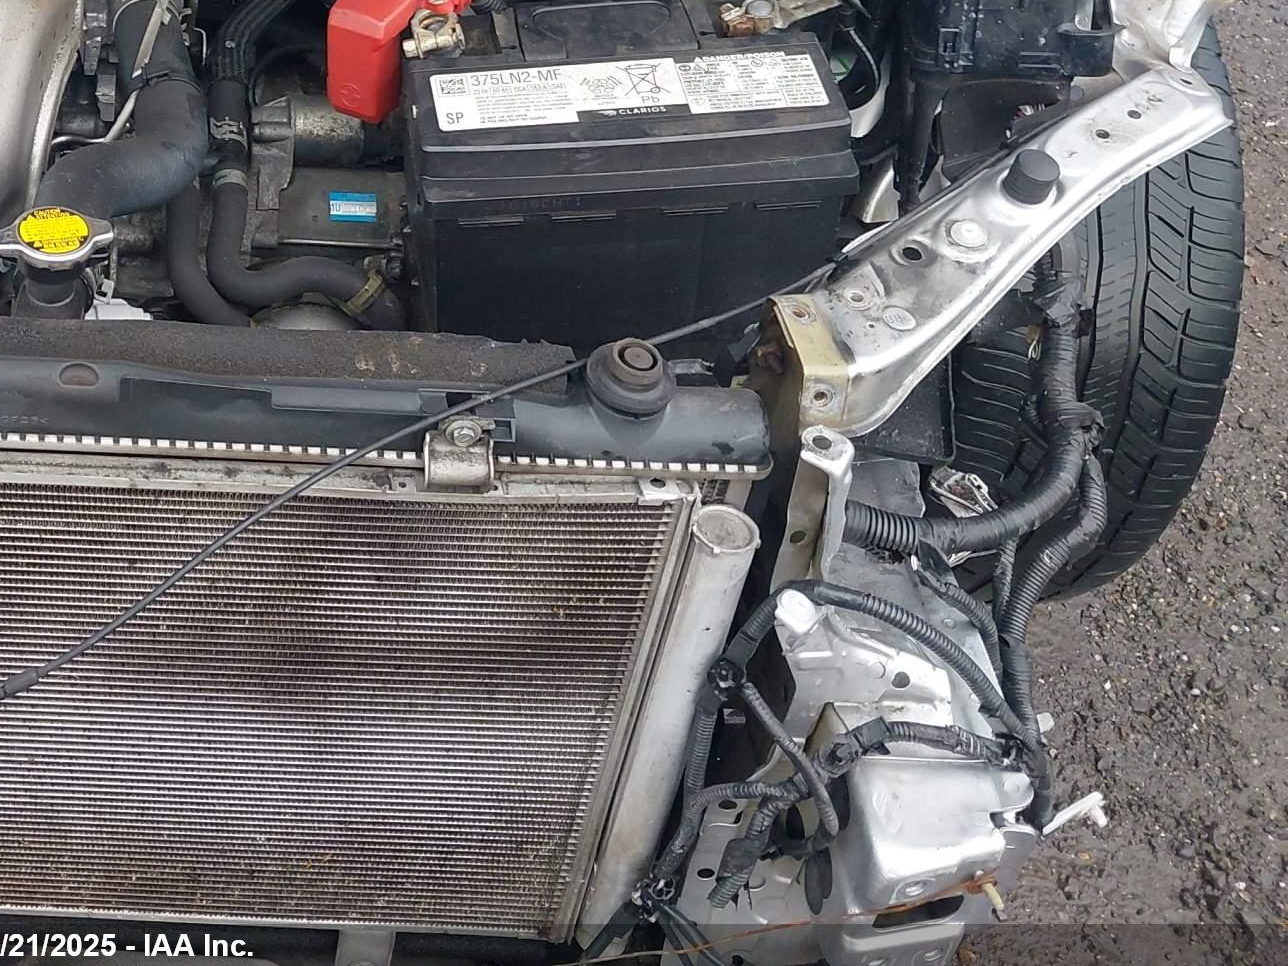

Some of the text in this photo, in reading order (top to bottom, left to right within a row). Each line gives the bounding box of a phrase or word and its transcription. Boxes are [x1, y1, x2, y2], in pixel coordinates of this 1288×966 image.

[470, 68, 562, 87] 375LN2-MF
[641, 95, 660, 104] Pb
[618, 105, 667, 115] CLARIOS
[446, 112, 464, 125] SP
